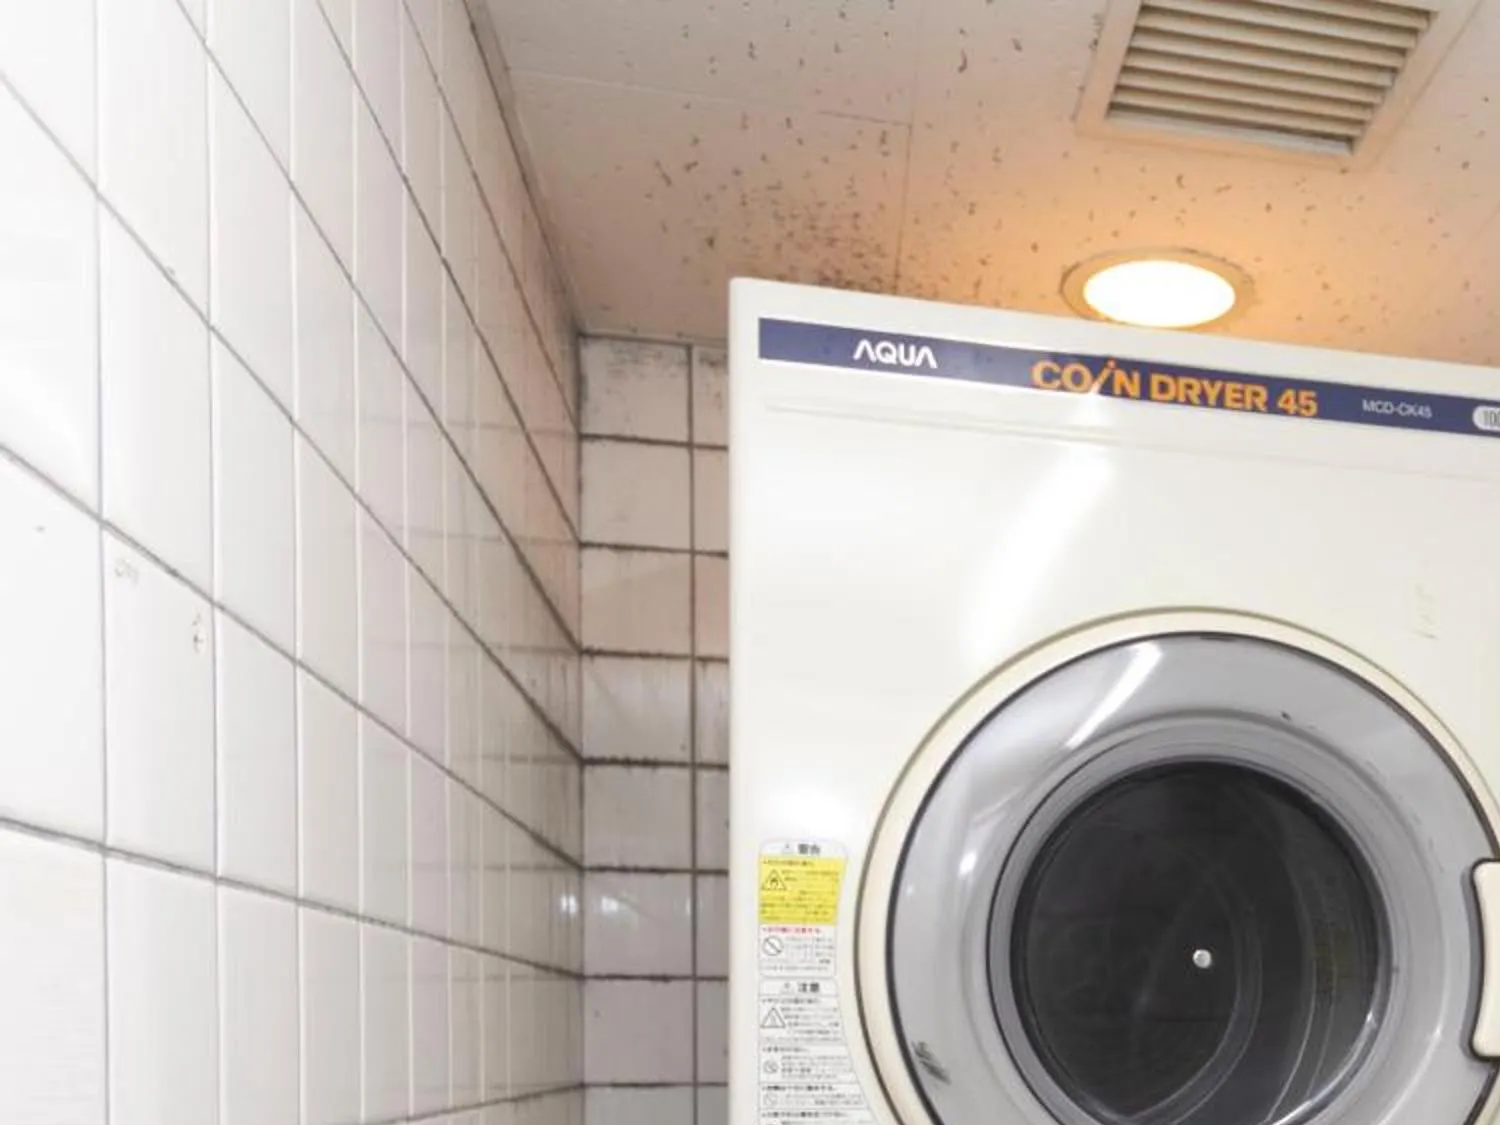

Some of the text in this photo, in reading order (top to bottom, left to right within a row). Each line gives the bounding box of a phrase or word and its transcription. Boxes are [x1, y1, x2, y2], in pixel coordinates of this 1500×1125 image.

[853, 340, 937, 369] AQUA
[1151, 373, 1267, 412] DRYER
[1277, 388, 1318, 417] 45
